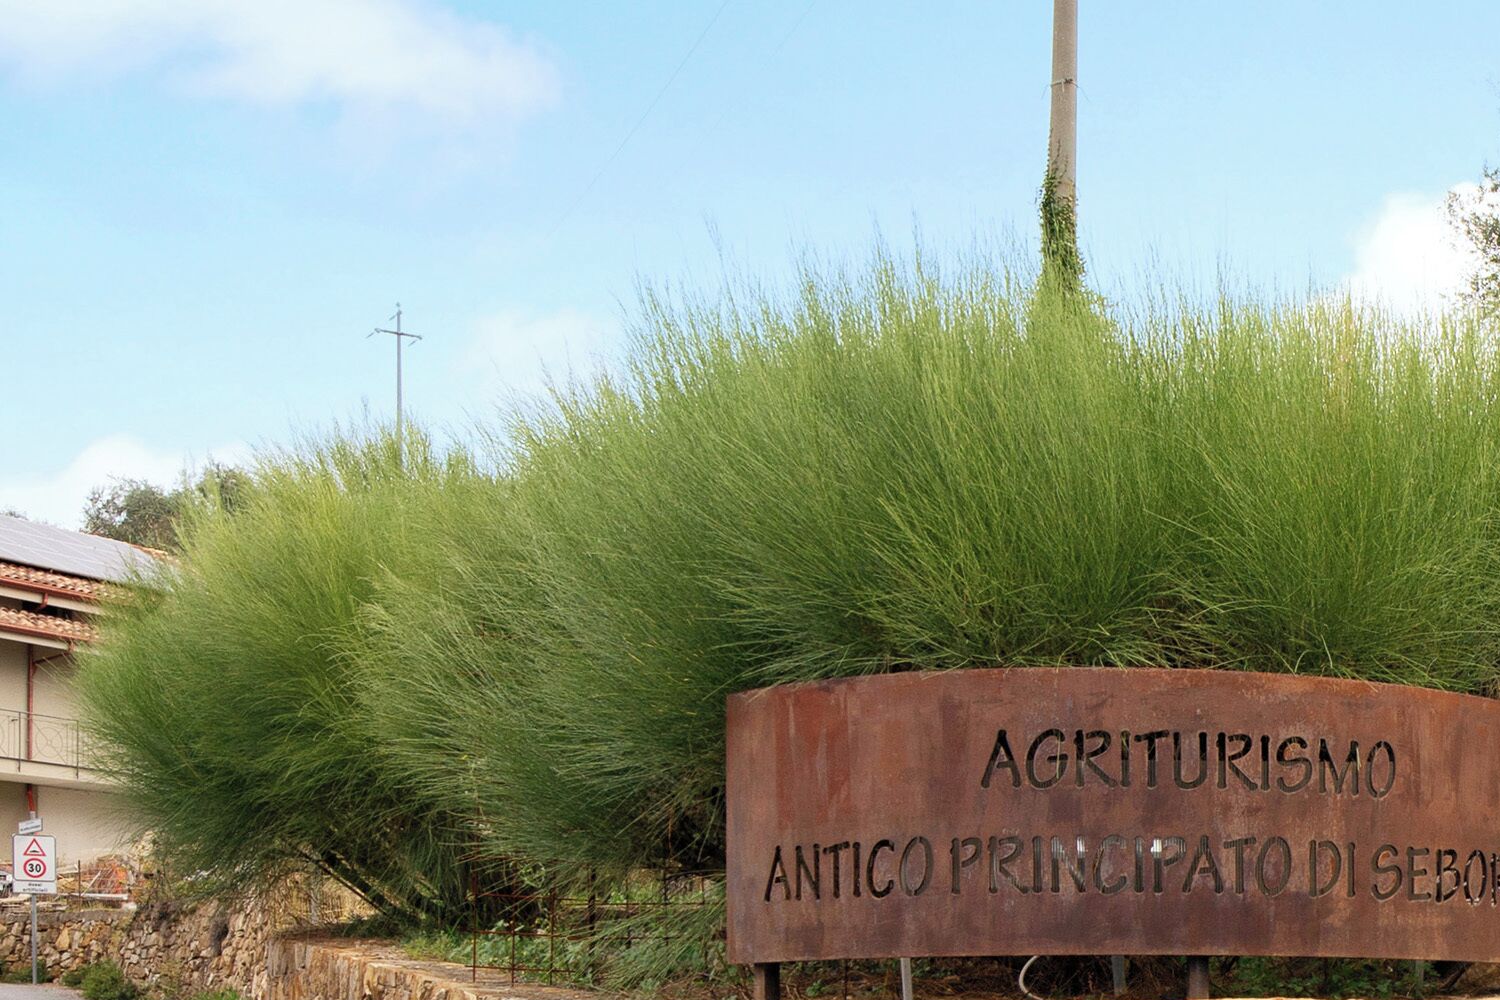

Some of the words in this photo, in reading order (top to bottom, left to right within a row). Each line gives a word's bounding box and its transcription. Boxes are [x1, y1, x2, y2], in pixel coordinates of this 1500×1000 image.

[980, 728, 1397, 799] AGRITURISMO
[28, 863, 41, 873] 30
[764, 834, 934, 902] ANTICO
[949, 833, 1293, 896] PRINCIPATO
[1307, 838, 1357, 899] DI
